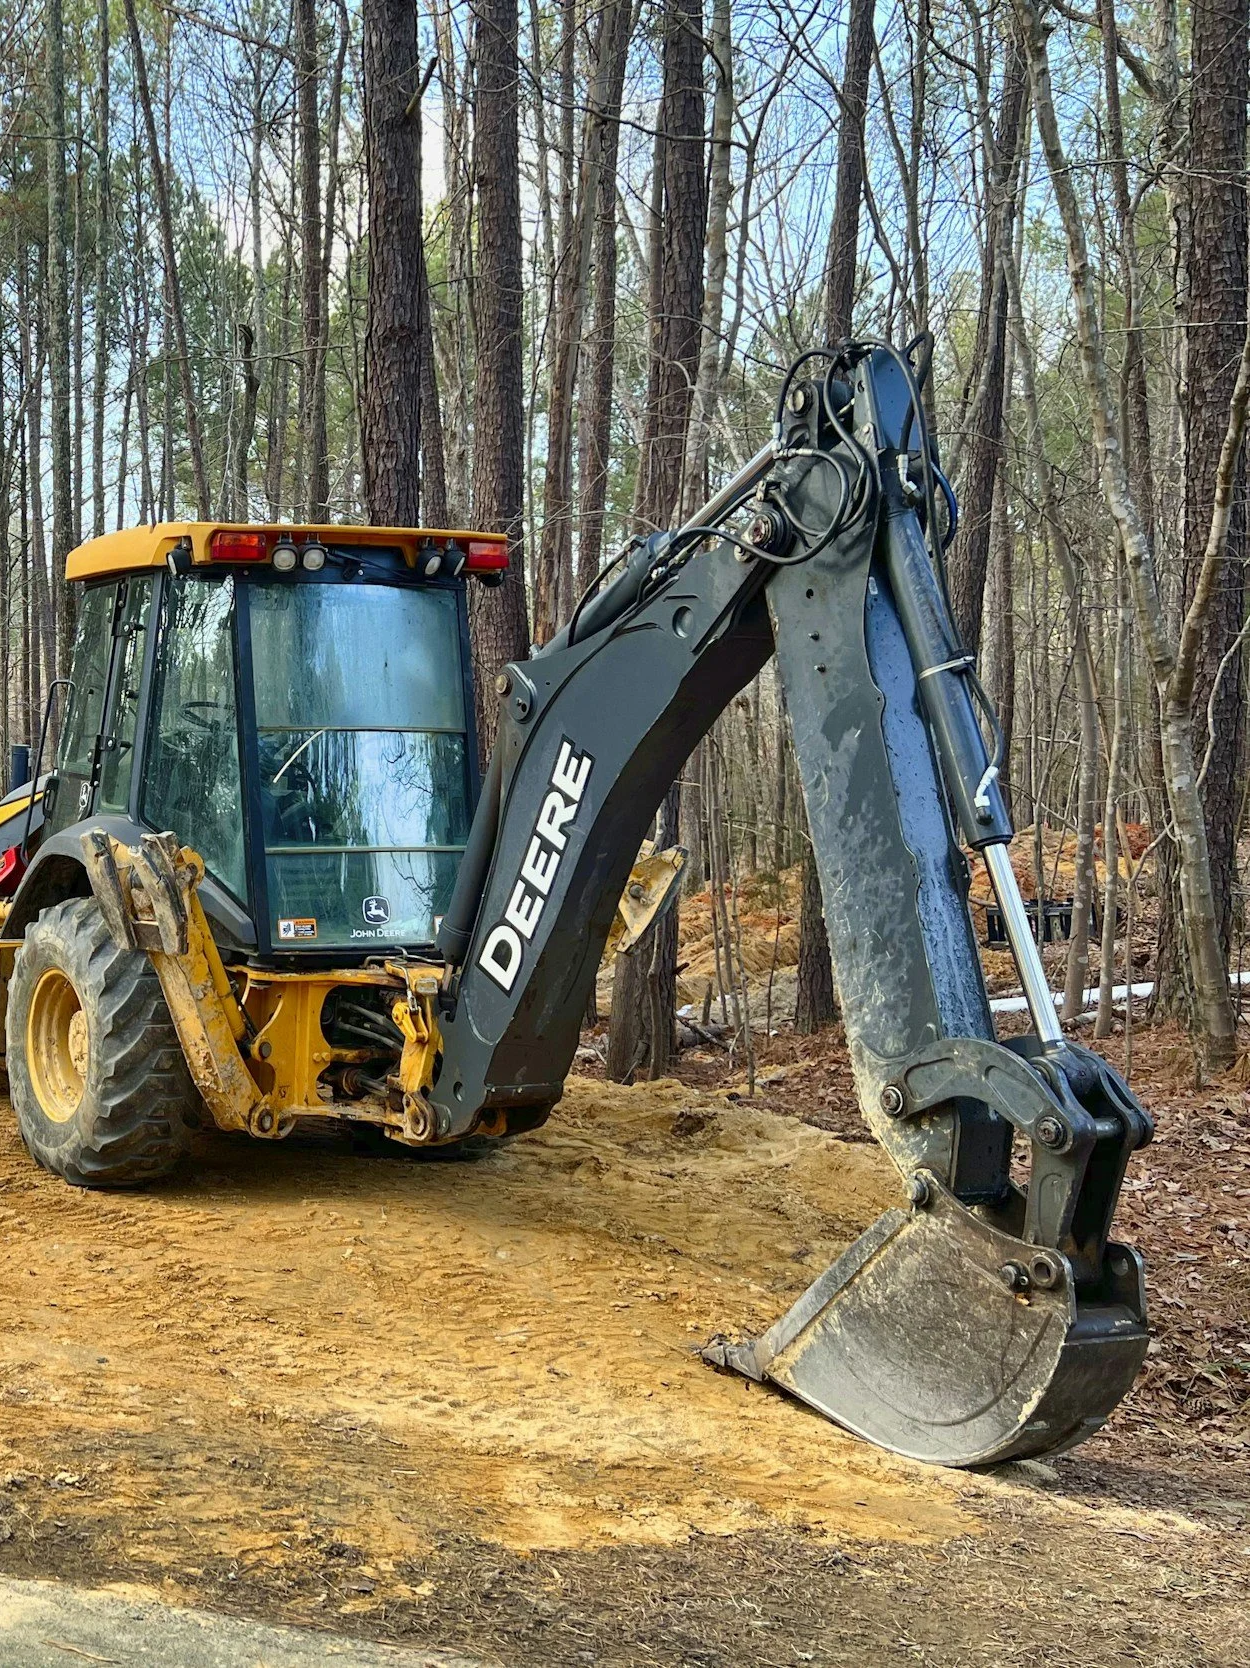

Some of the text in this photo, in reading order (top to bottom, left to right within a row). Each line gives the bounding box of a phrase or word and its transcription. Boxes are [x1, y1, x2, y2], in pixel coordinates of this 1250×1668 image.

[479, 741, 592, 991] DEERE
[350, 928, 406, 938] JOHN DEERE
